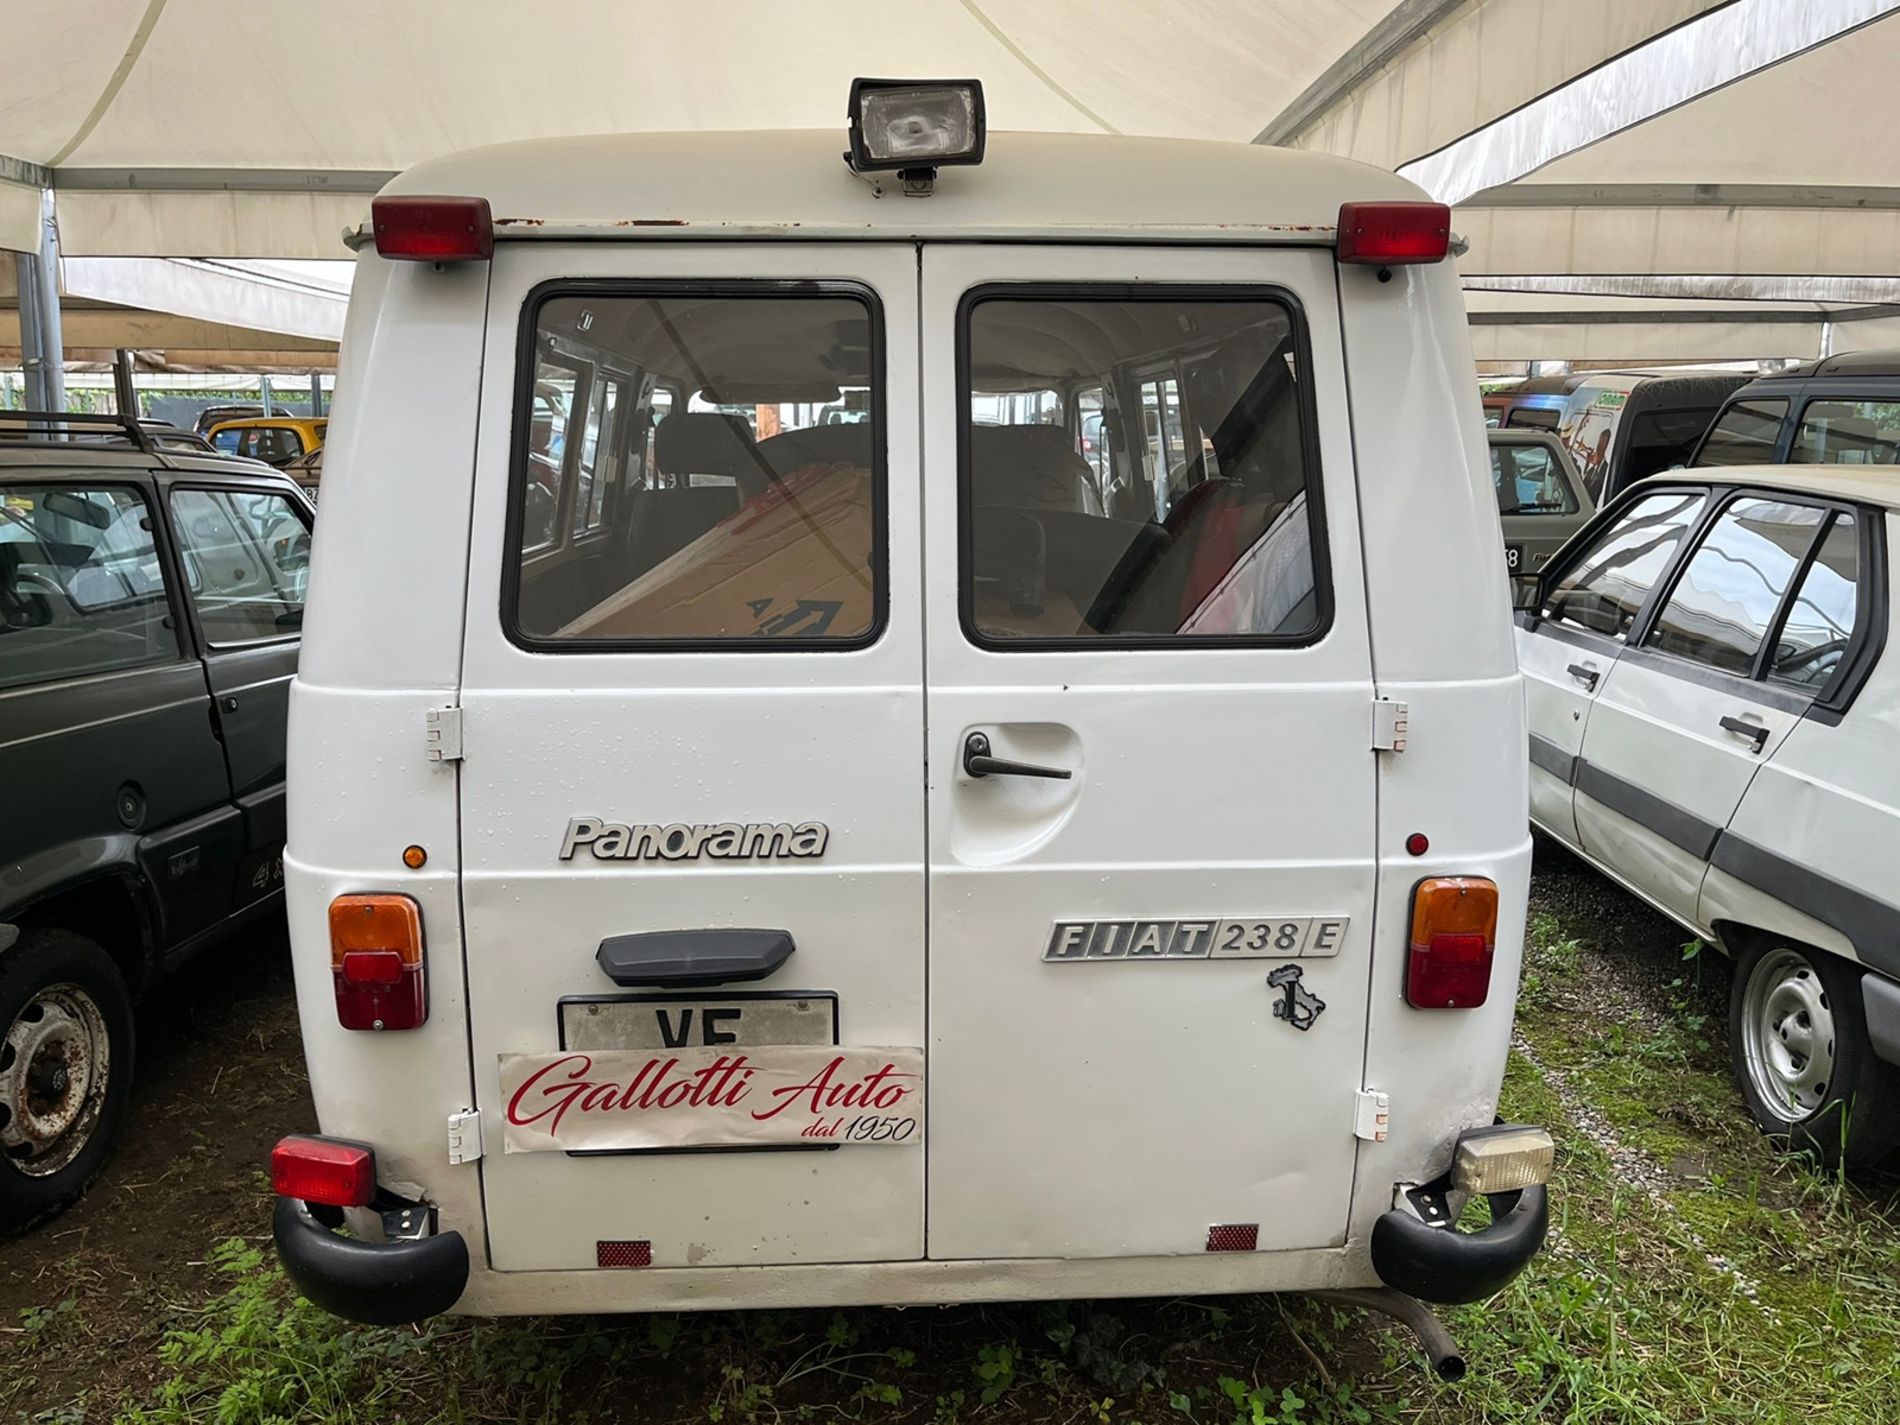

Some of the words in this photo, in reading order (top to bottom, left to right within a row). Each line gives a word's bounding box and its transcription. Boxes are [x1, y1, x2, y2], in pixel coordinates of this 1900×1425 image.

[559, 816, 829, 861] Panorama
[1056, 923, 1210, 956] FIAT
[1220, 923, 1300, 951] 238
[1313, 922, 1341, 950] E
[507, 1055, 767, 1137] Gallotti
[751, 1056, 924, 1120] Auto
[801, 1117, 842, 1138] dal
[843, 1115, 917, 1141] 1950
